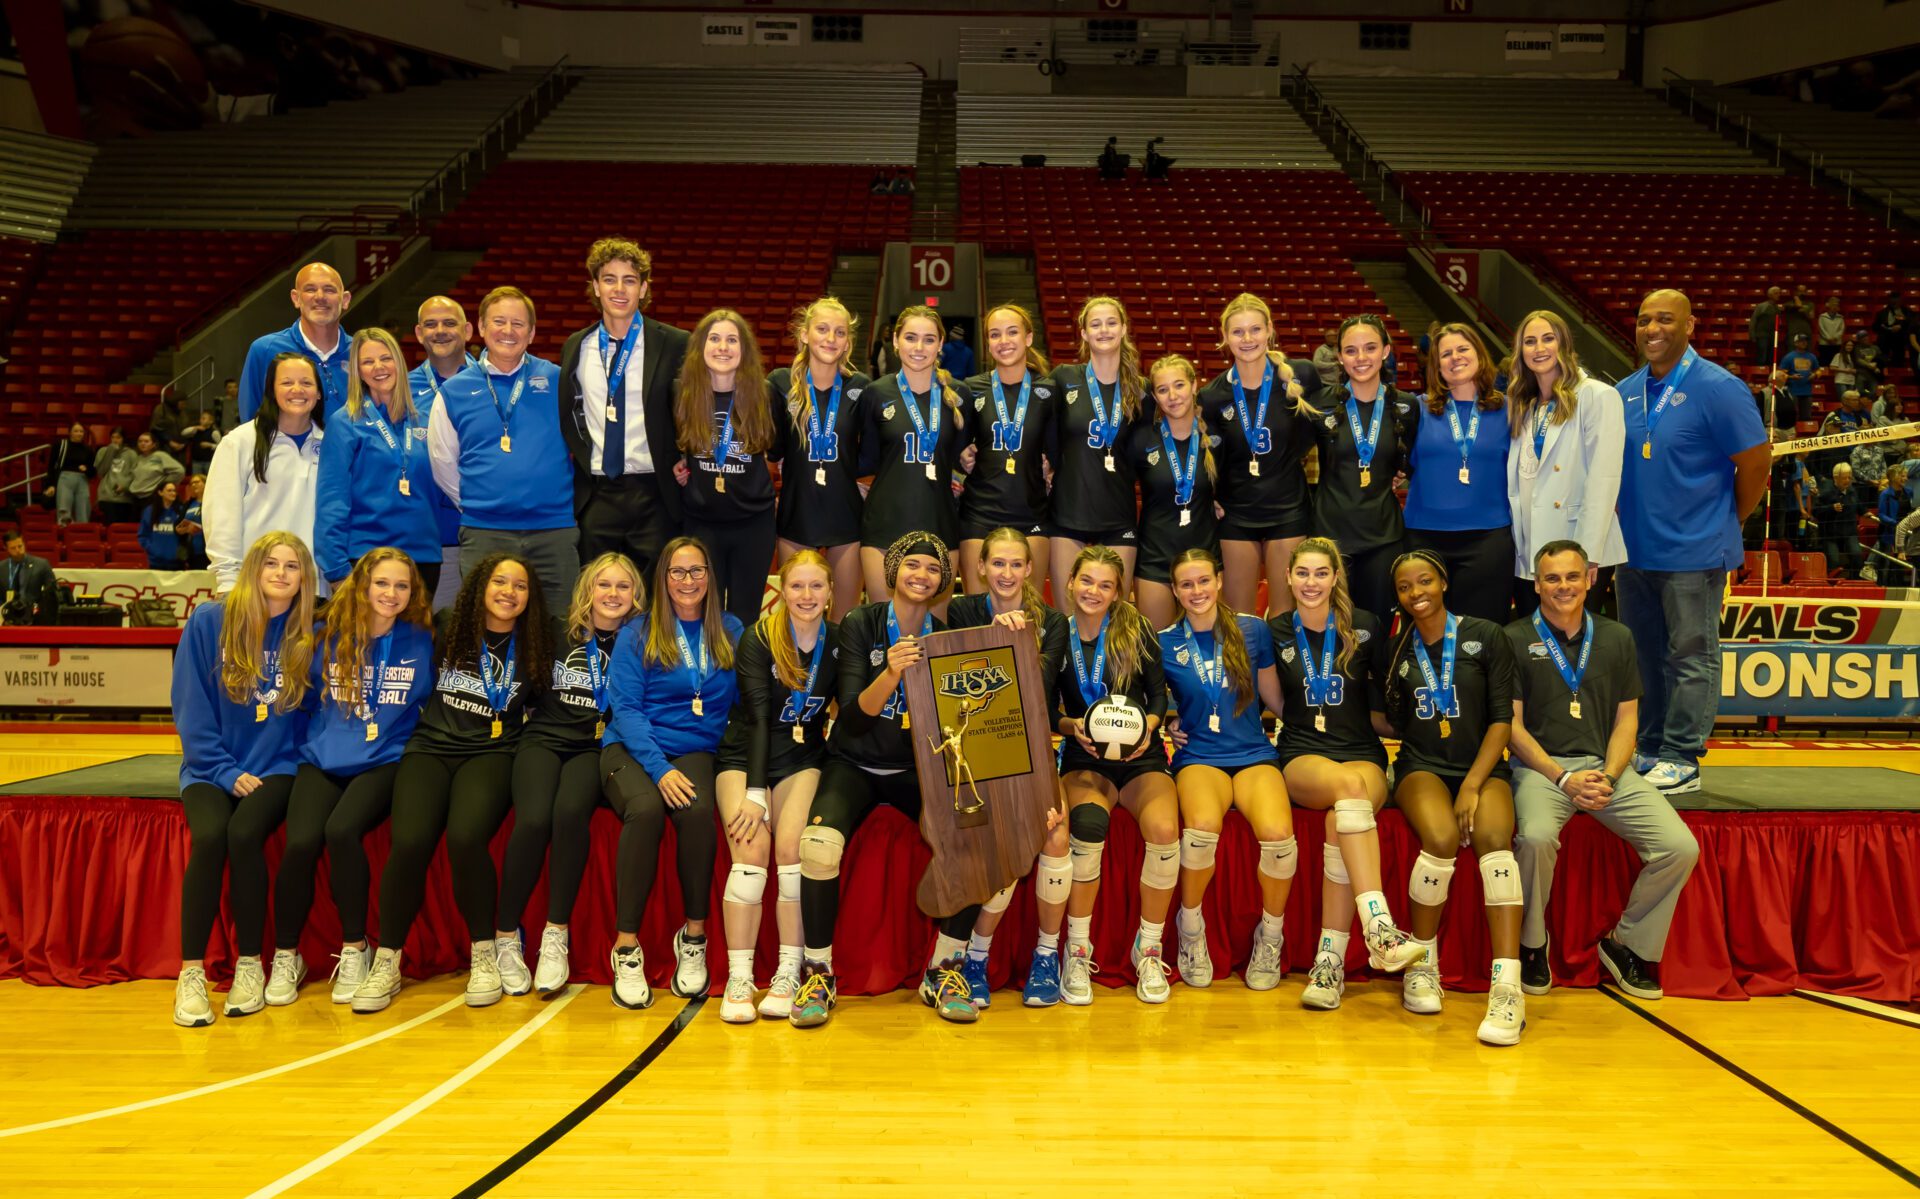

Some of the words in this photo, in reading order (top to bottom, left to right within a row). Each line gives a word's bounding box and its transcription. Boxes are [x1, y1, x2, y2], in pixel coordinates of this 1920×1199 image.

[707, 25, 743, 35] CASTLE
[1506, 41, 1552, 50] BELLMONT
[913, 258, 951, 287] 10
[1654, 386, 1674, 412] CHAMPION
[1790, 438, 1819, 450] IHSAA
[1822, 434, 1851, 446] STATE
[1854, 428, 1890, 441] FINALS
[1546, 638, 1567, 670] VOLLEYBALL
[5, 672, 58, 686] VARSITY
[64, 672, 105, 687] HOUSE
[943, 666, 1009, 695] IHSAA
[1092, 655, 1103, 684] CHAMPION
[1721, 651, 1919, 699] IONSH
[442, 693, 493, 718] VOLLEYBALL
[780, 696, 826, 722] 27
[968, 728, 987, 736] STATE
[988, 722, 1022, 734] CHAMPIONS
[984, 715, 1022, 726] VOLLEYBALL
[997, 731, 1016, 740] CLASS
